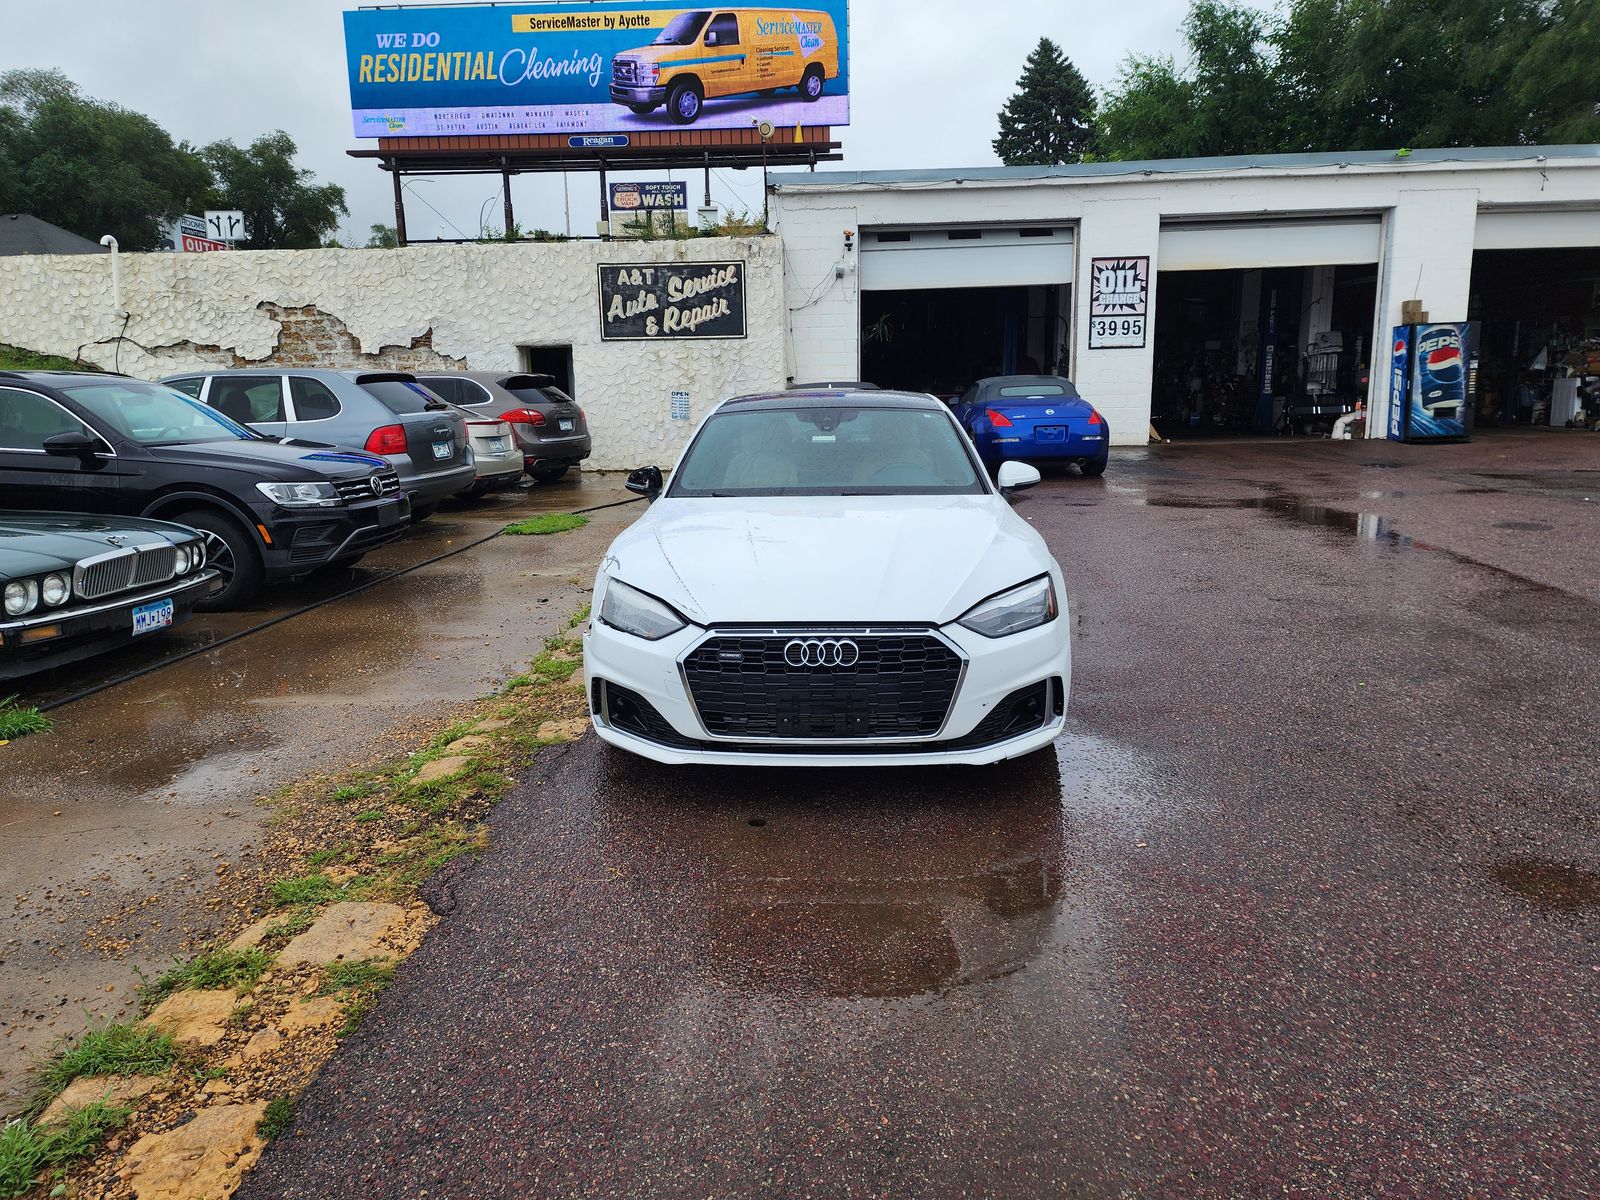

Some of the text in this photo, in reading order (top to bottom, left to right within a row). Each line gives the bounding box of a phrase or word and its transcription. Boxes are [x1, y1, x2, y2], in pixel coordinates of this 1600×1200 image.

[530, 14, 651, 30] ServiceMaster by Ayotte
[375, 31, 441, 49] WE DO
[800, 35, 820, 49] Clean
[359, 46, 604, 88] RESIDENTIAL Cleaning
[434, 112, 471, 120] NORTHFIELD
[525, 110, 554, 118] MANKATO
[564, 109, 590, 117] WASECA
[476, 122, 499, 130] AUSTIN
[509, 122, 531, 130] ALBERT
[534, 121, 546, 129] LEA
[583, 136, 615, 147] Reagan
[641, 193, 684, 206] WASH
[181, 218, 206, 230] ROOMS
[186, 238, 227, 252] OUTLE
[617, 268, 655, 286] A&T
[1099, 269, 1142, 294] OIL
[606, 264, 738, 324] Auto Service
[1098, 293, 1142, 305] CHANGE
[645, 296, 732, 337] & Repair
[1391, 368, 1403, 436] PEPSI
